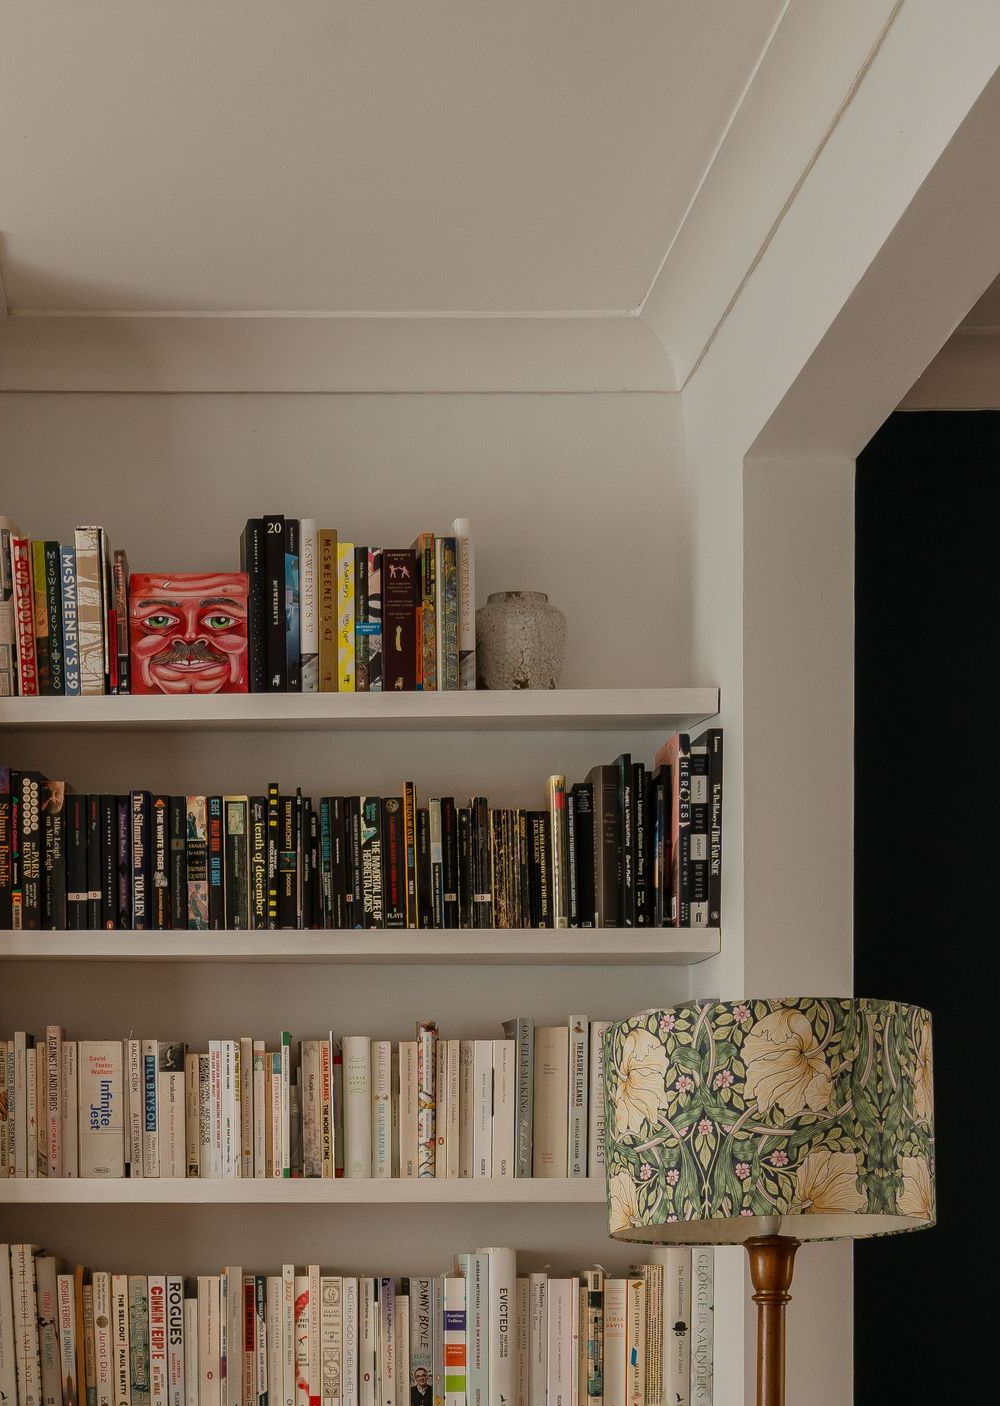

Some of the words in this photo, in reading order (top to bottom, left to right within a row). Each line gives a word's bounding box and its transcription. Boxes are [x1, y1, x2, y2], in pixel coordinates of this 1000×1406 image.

[267, 523, 281, 533] 20
[304, 538, 312, 618] McSWEENEY'S
[323, 539, 332, 622] McSWEENEY'S
[461, 538, 470, 616] McSWEENEY'S
[63, 554, 77, 665] McSWEENEY'S
[305, 622, 313, 633] 32
[462, 622, 470, 632] 32
[67, 672, 78, 689] 39
[134, 794, 143, 811] The
[679, 762, 690, 818] HEROES
[0, 803, 8, 841] Salman
[46, 816, 51, 826] on
[695, 808, 703, 829] LOVE
[53, 837, 61, 859] Leigh
[134, 813, 143, 868] Silmarillion
[255, 823, 264, 850] tenth
[371, 840, 380, 854] THE
[712, 830, 720, 844] THE
[23, 842, 31, 878] REVIEW
[31, 851, 39, 878] PARIS
[45, 849, 53, 871] Leigh
[211, 858, 220, 869] EXIT
[253, 853, 264, 863] of
[712, 845, 720, 858] FAR
[0, 845, 8, 887] Rushdie
[212, 870, 220, 886] GHOST
[363, 850, 372, 888] HENRIETTA
[372, 855, 381, 892] IMMORTAL
[711, 859, 720, 875] SIDE
[255, 866, 264, 916] december
[695, 864, 704, 898] MOVIES
[135, 874, 144, 916] TOLKIEN
[364, 889, 373, 912] LACKS
[373, 895, 382, 910] LIFE
[373, 911, 382, 920] OF
[521, 1025, 529, 1039] ON
[49, 1036, 57, 1067] AGAINST
[146, 1056, 154, 1082] BILL
[520, 1043, 529, 1113] FILM-MAKING
[49, 1069, 58, 1111] LANDLORDS
[100, 1080, 112, 1126] Infinite
[90, 1104, 101, 1130] Jest
[146, 1083, 155, 1131] BRYSON
[324, 1136, 329, 1144] OF
[596, 1115, 604, 1166] TEMPEST
[61, 1279, 70, 1304] JOSHUA
[697, 1255, 708, 1308] GEORGE
[419, 1280, 429, 1312] DANNY
[62, 1305, 71, 1328] FERRIS
[169, 1282, 182, 1345] ROGUES
[499, 1288, 508, 1332] EVICTED
[99, 1330, 107, 1359] Junot
[419, 1315, 429, 1349] BOYLE
[100, 1362, 108, 1383] Díaz
[696, 1327, 707, 1399] SAUNDERS
